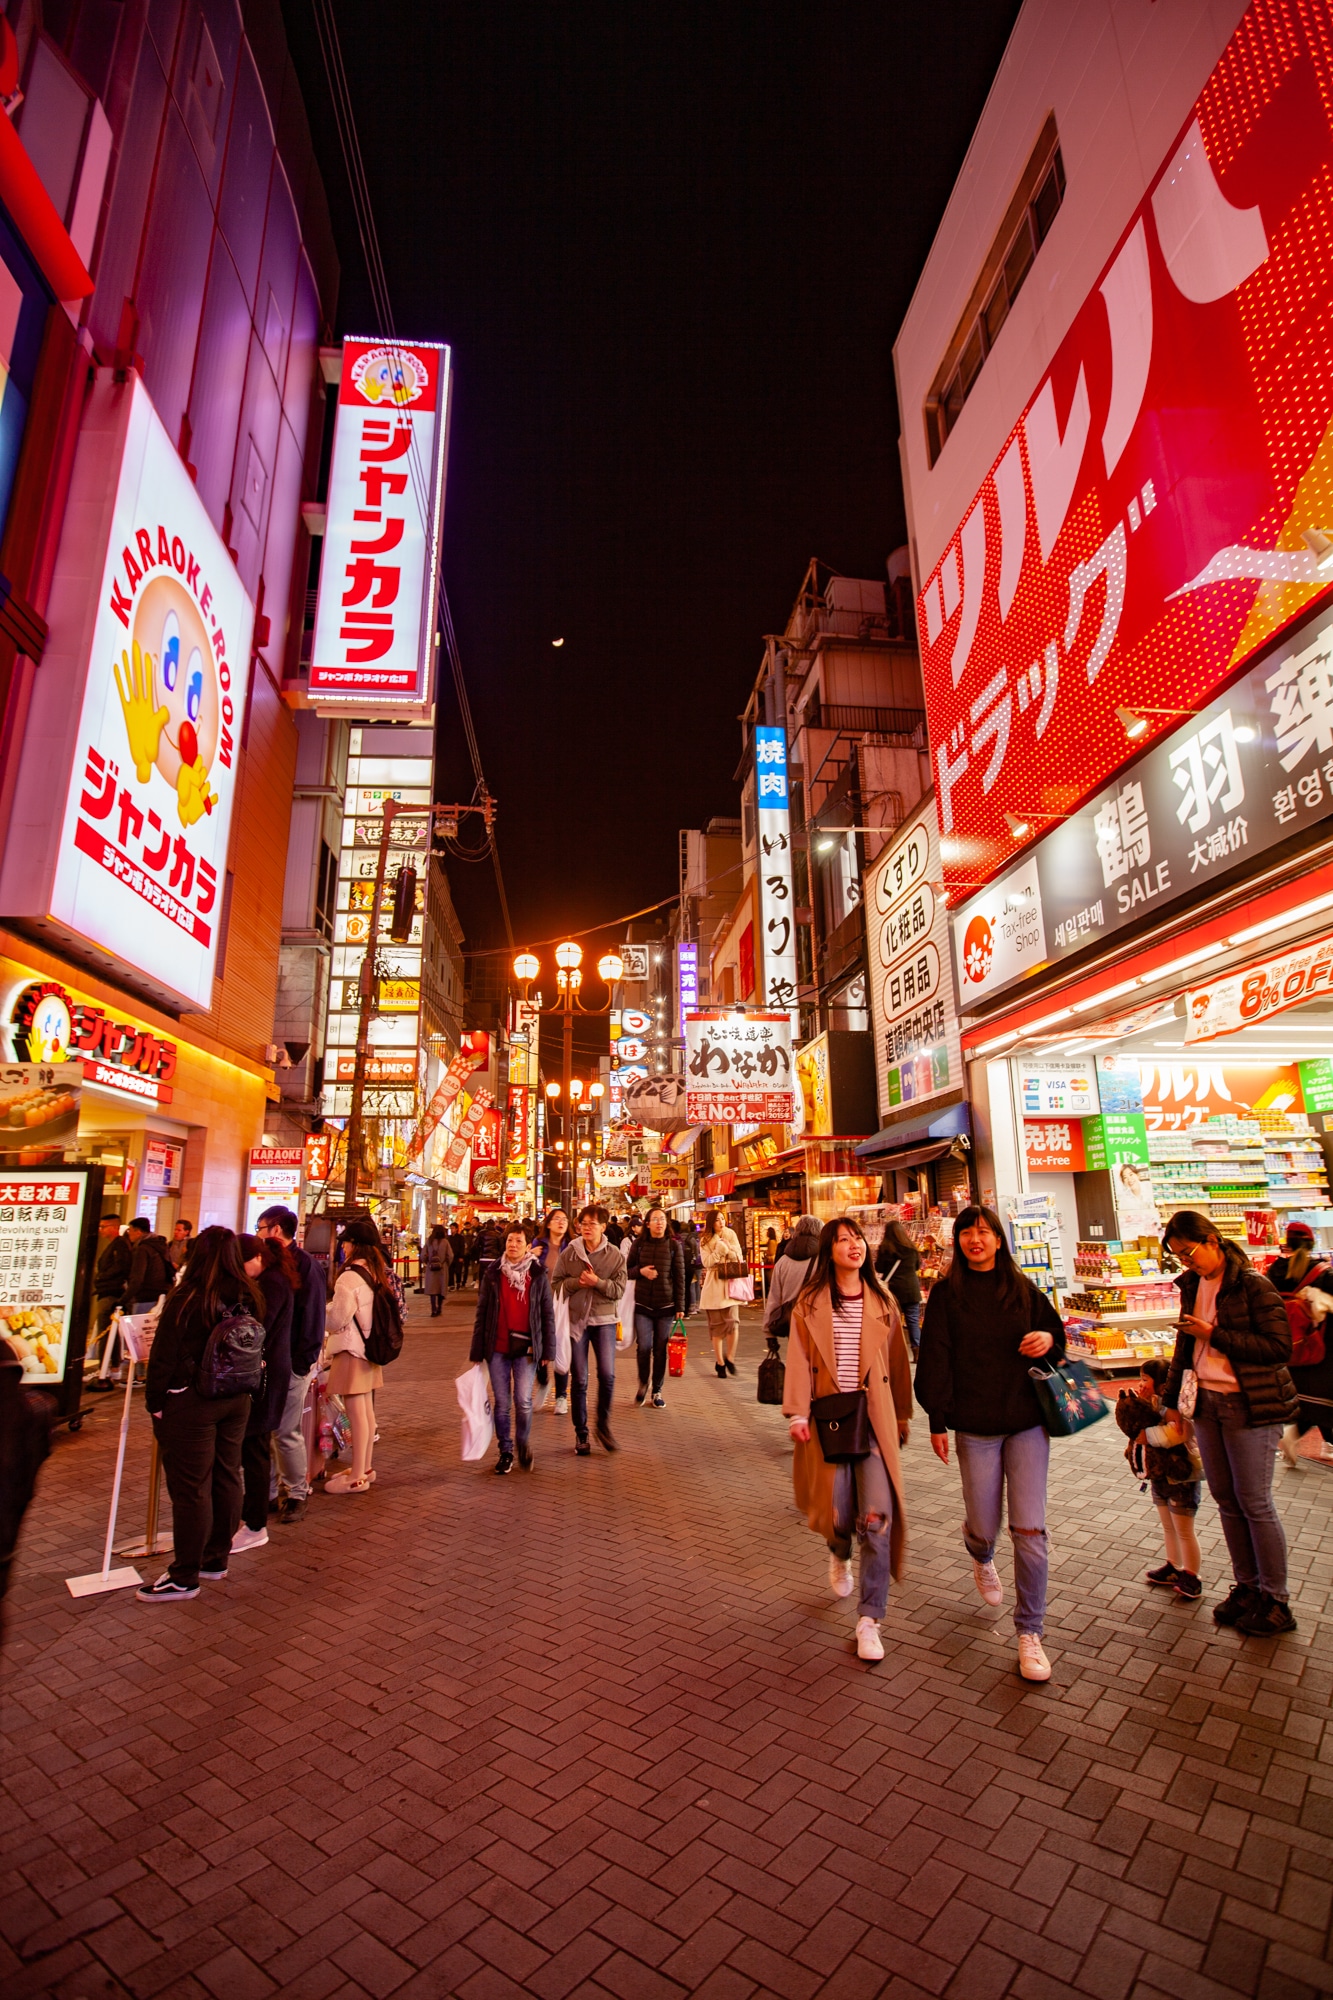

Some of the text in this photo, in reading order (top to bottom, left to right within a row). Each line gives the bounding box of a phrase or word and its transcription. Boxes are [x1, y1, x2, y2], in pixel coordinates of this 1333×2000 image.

[341, 418, 413, 663] ジャンカラ
[937, 478, 1157, 840] ドラッグ
[80, 745, 217, 914] ジャンカラ
[757, 739, 795, 1013] 焼肉 いろりや
[882, 841, 919, 898] くすり
[1116, 859, 1173, 914] SALE
[886, 896, 926, 956] 化粧品
[1001, 907, 1038, 940] Tax-free
[1054, 899, 1105, 947] 세일판매
[1016, 928, 1040, 952] Shop
[623, 953, 644, 971] 牛角
[890, 955, 932, 1011] 日用品
[78, 1007, 177, 1081] ジャンカラ
[689, 1037, 790, 1079] わなか
[339, 1063, 413, 1073] CAE&INFO
[1047, 1081, 1067, 1089] VISA
[708, 1103, 747, 1120] No.1
[1024, 1124, 1072, 1151] 免税
[252, 1149, 301, 1160] KARAOKE
[0, 1185, 71, 1201] 大起水産
[0, 1206, 67, 1221] 回転寿司
[43, 1225, 69, 1234] sushi
[0, 1238, 60, 1253] 回转寿司
[27, 1272, 55, 1288] 초밥
